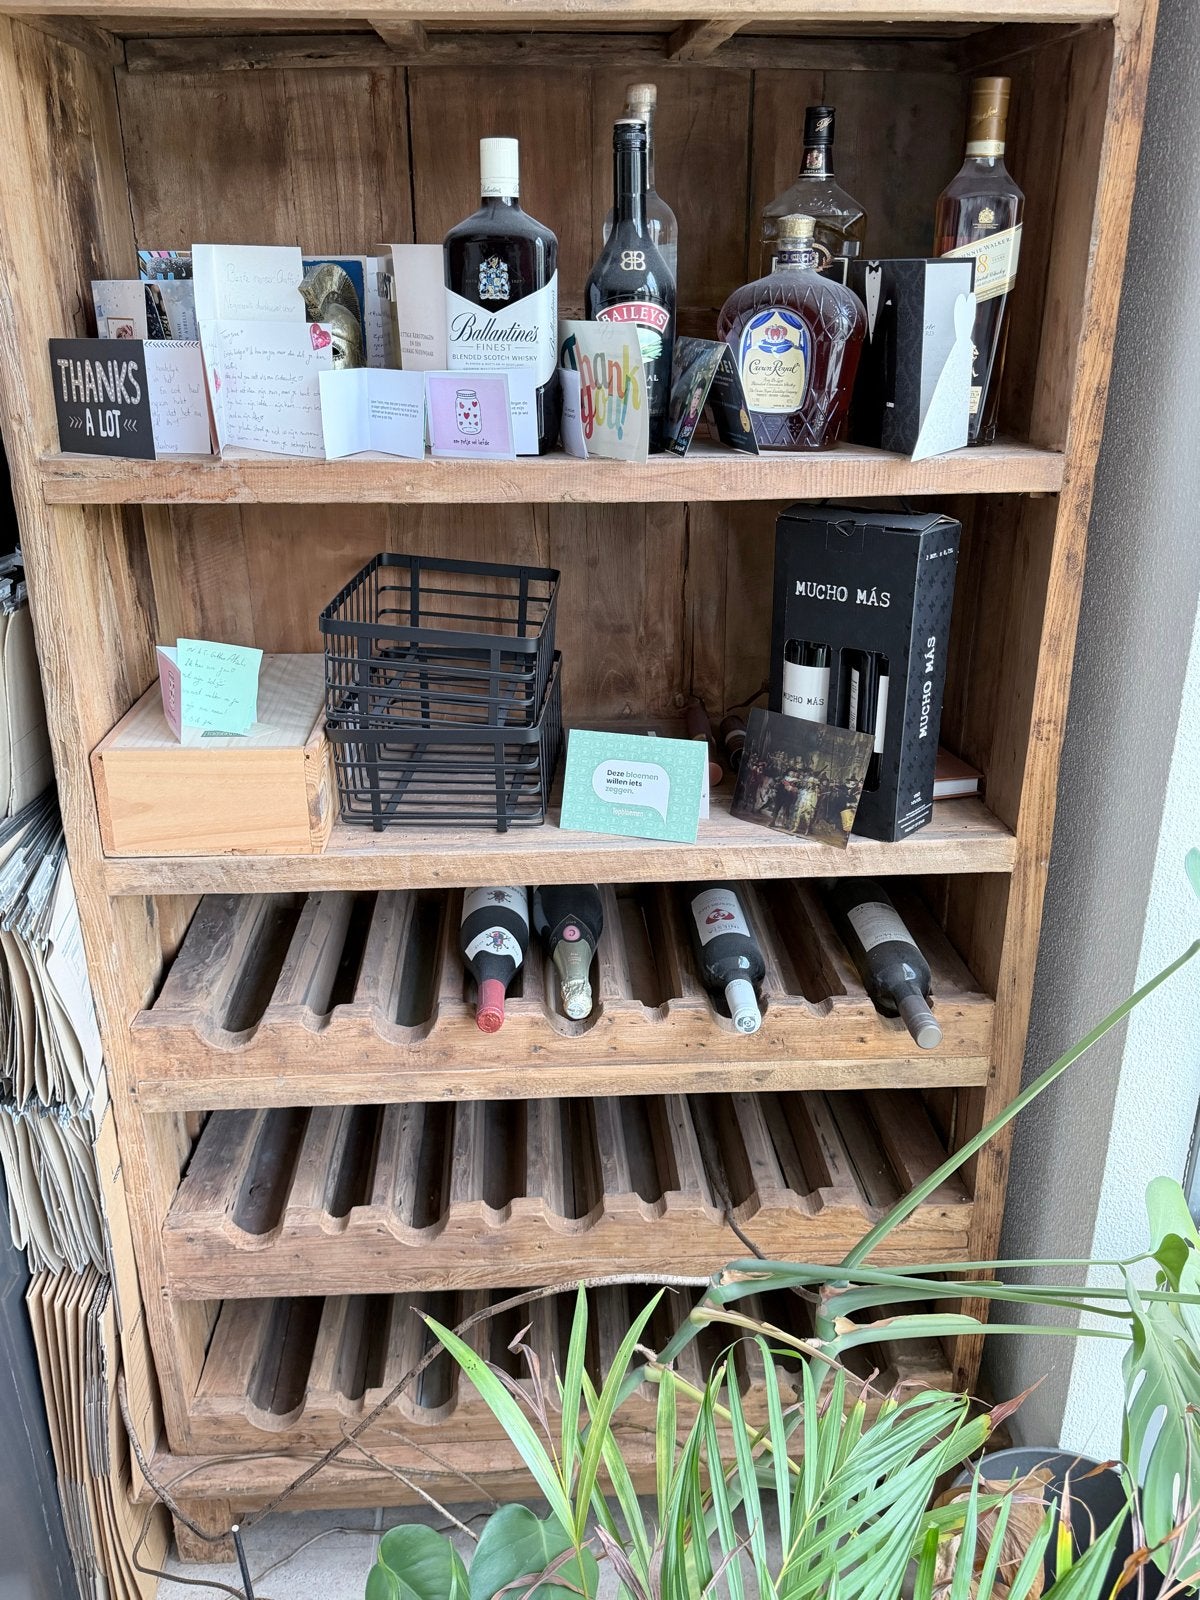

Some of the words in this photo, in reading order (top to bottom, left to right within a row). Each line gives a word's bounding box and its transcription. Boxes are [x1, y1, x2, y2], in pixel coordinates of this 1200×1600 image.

[601, 303, 667, 325] BAILEYS
[449, 312, 539, 342] Ballantine's
[476, 343, 512, 351] FINEST
[748, 358, 773, 375] Crown
[766, 359, 800, 377] Royal
[56, 358, 142, 405] THANKS
[85, 408, 96, 437] A
[98, 408, 121, 439] LOT
[795, 580, 848, 602] MUCHO
[855, 587, 891, 608] MÁS
[924, 635, 937, 675] MÁS
[806, 697, 825, 706] MÁS
[919, 678, 933, 740] MUCHO
[606, 769, 625, 777] Deze
[625, 771, 659, 781] bloemen
[606, 778, 628, 786] willen
[628, 779, 643, 787] iets
[605, 786, 634, 795] zeggen.
